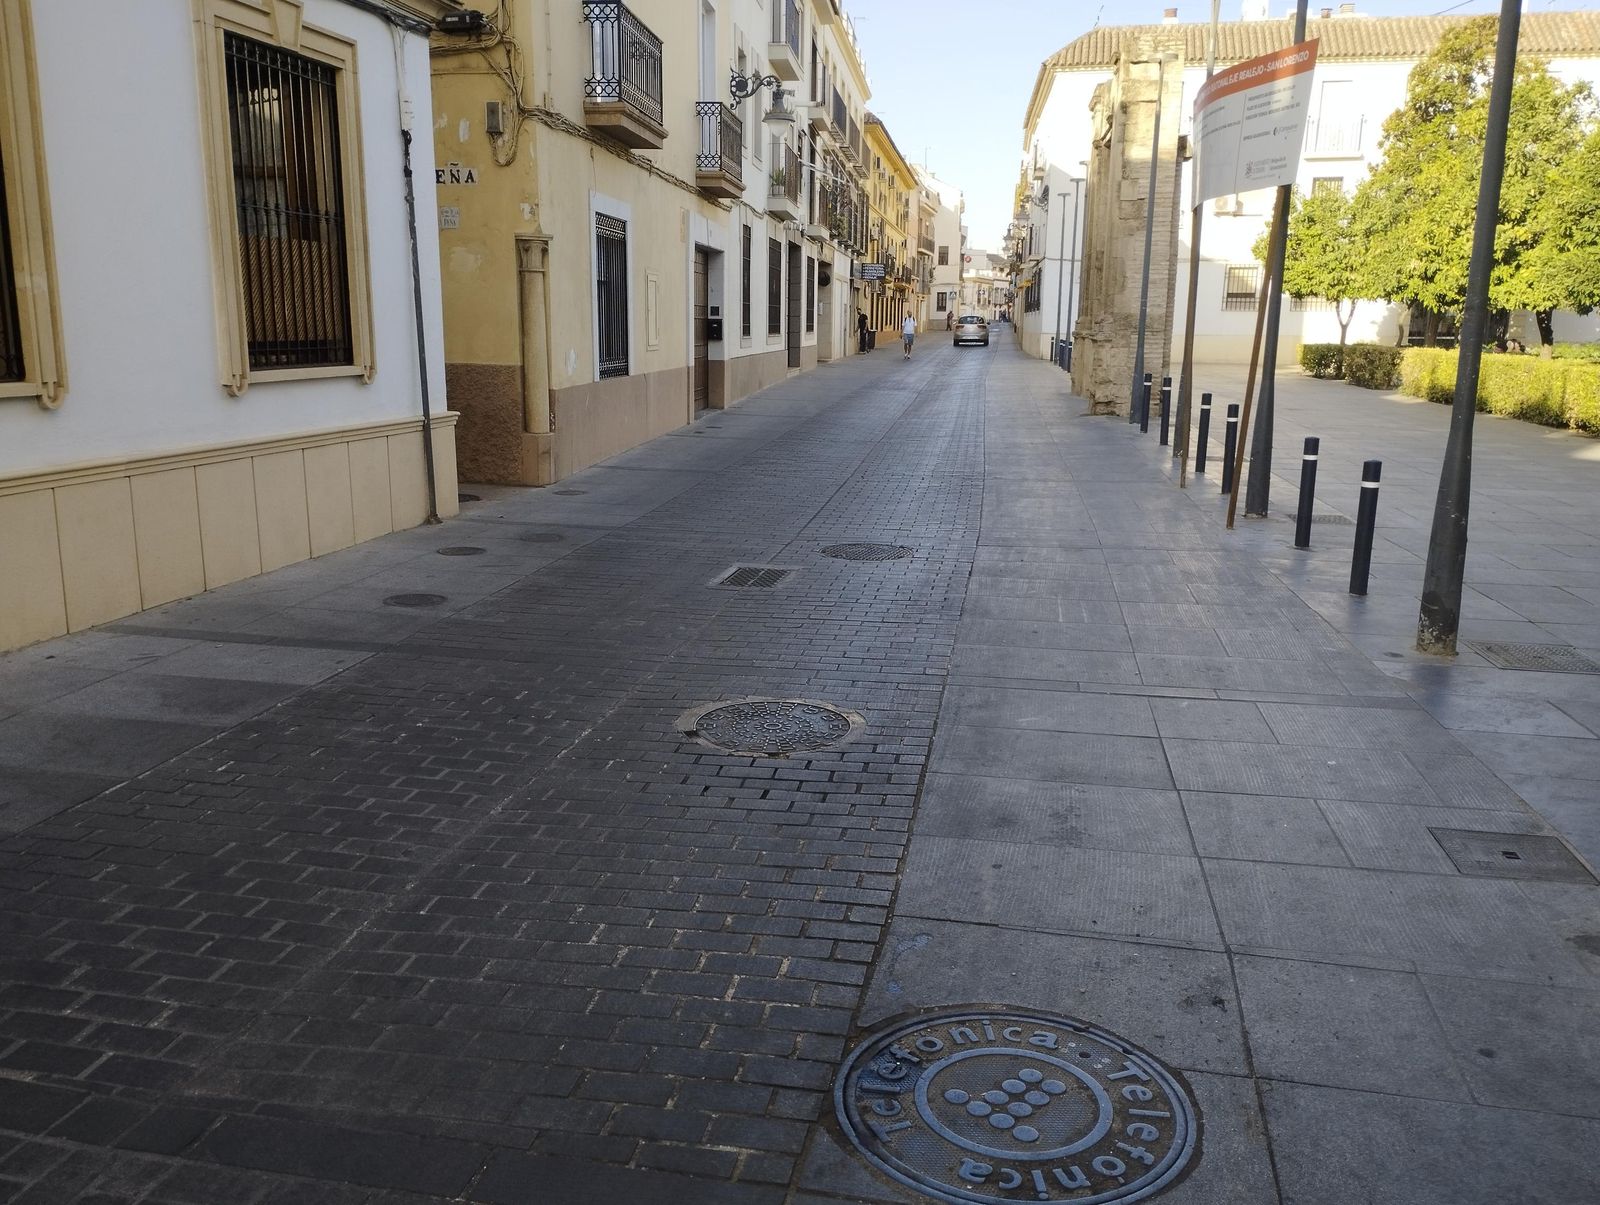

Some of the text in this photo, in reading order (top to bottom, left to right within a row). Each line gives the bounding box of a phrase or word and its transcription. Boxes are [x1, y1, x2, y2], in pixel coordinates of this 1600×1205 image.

[1239, 64, 1264, 81] REALEJO
[1266, 59, 1280, 72] SAN
[1280, 50, 1310, 68] LORENZO
